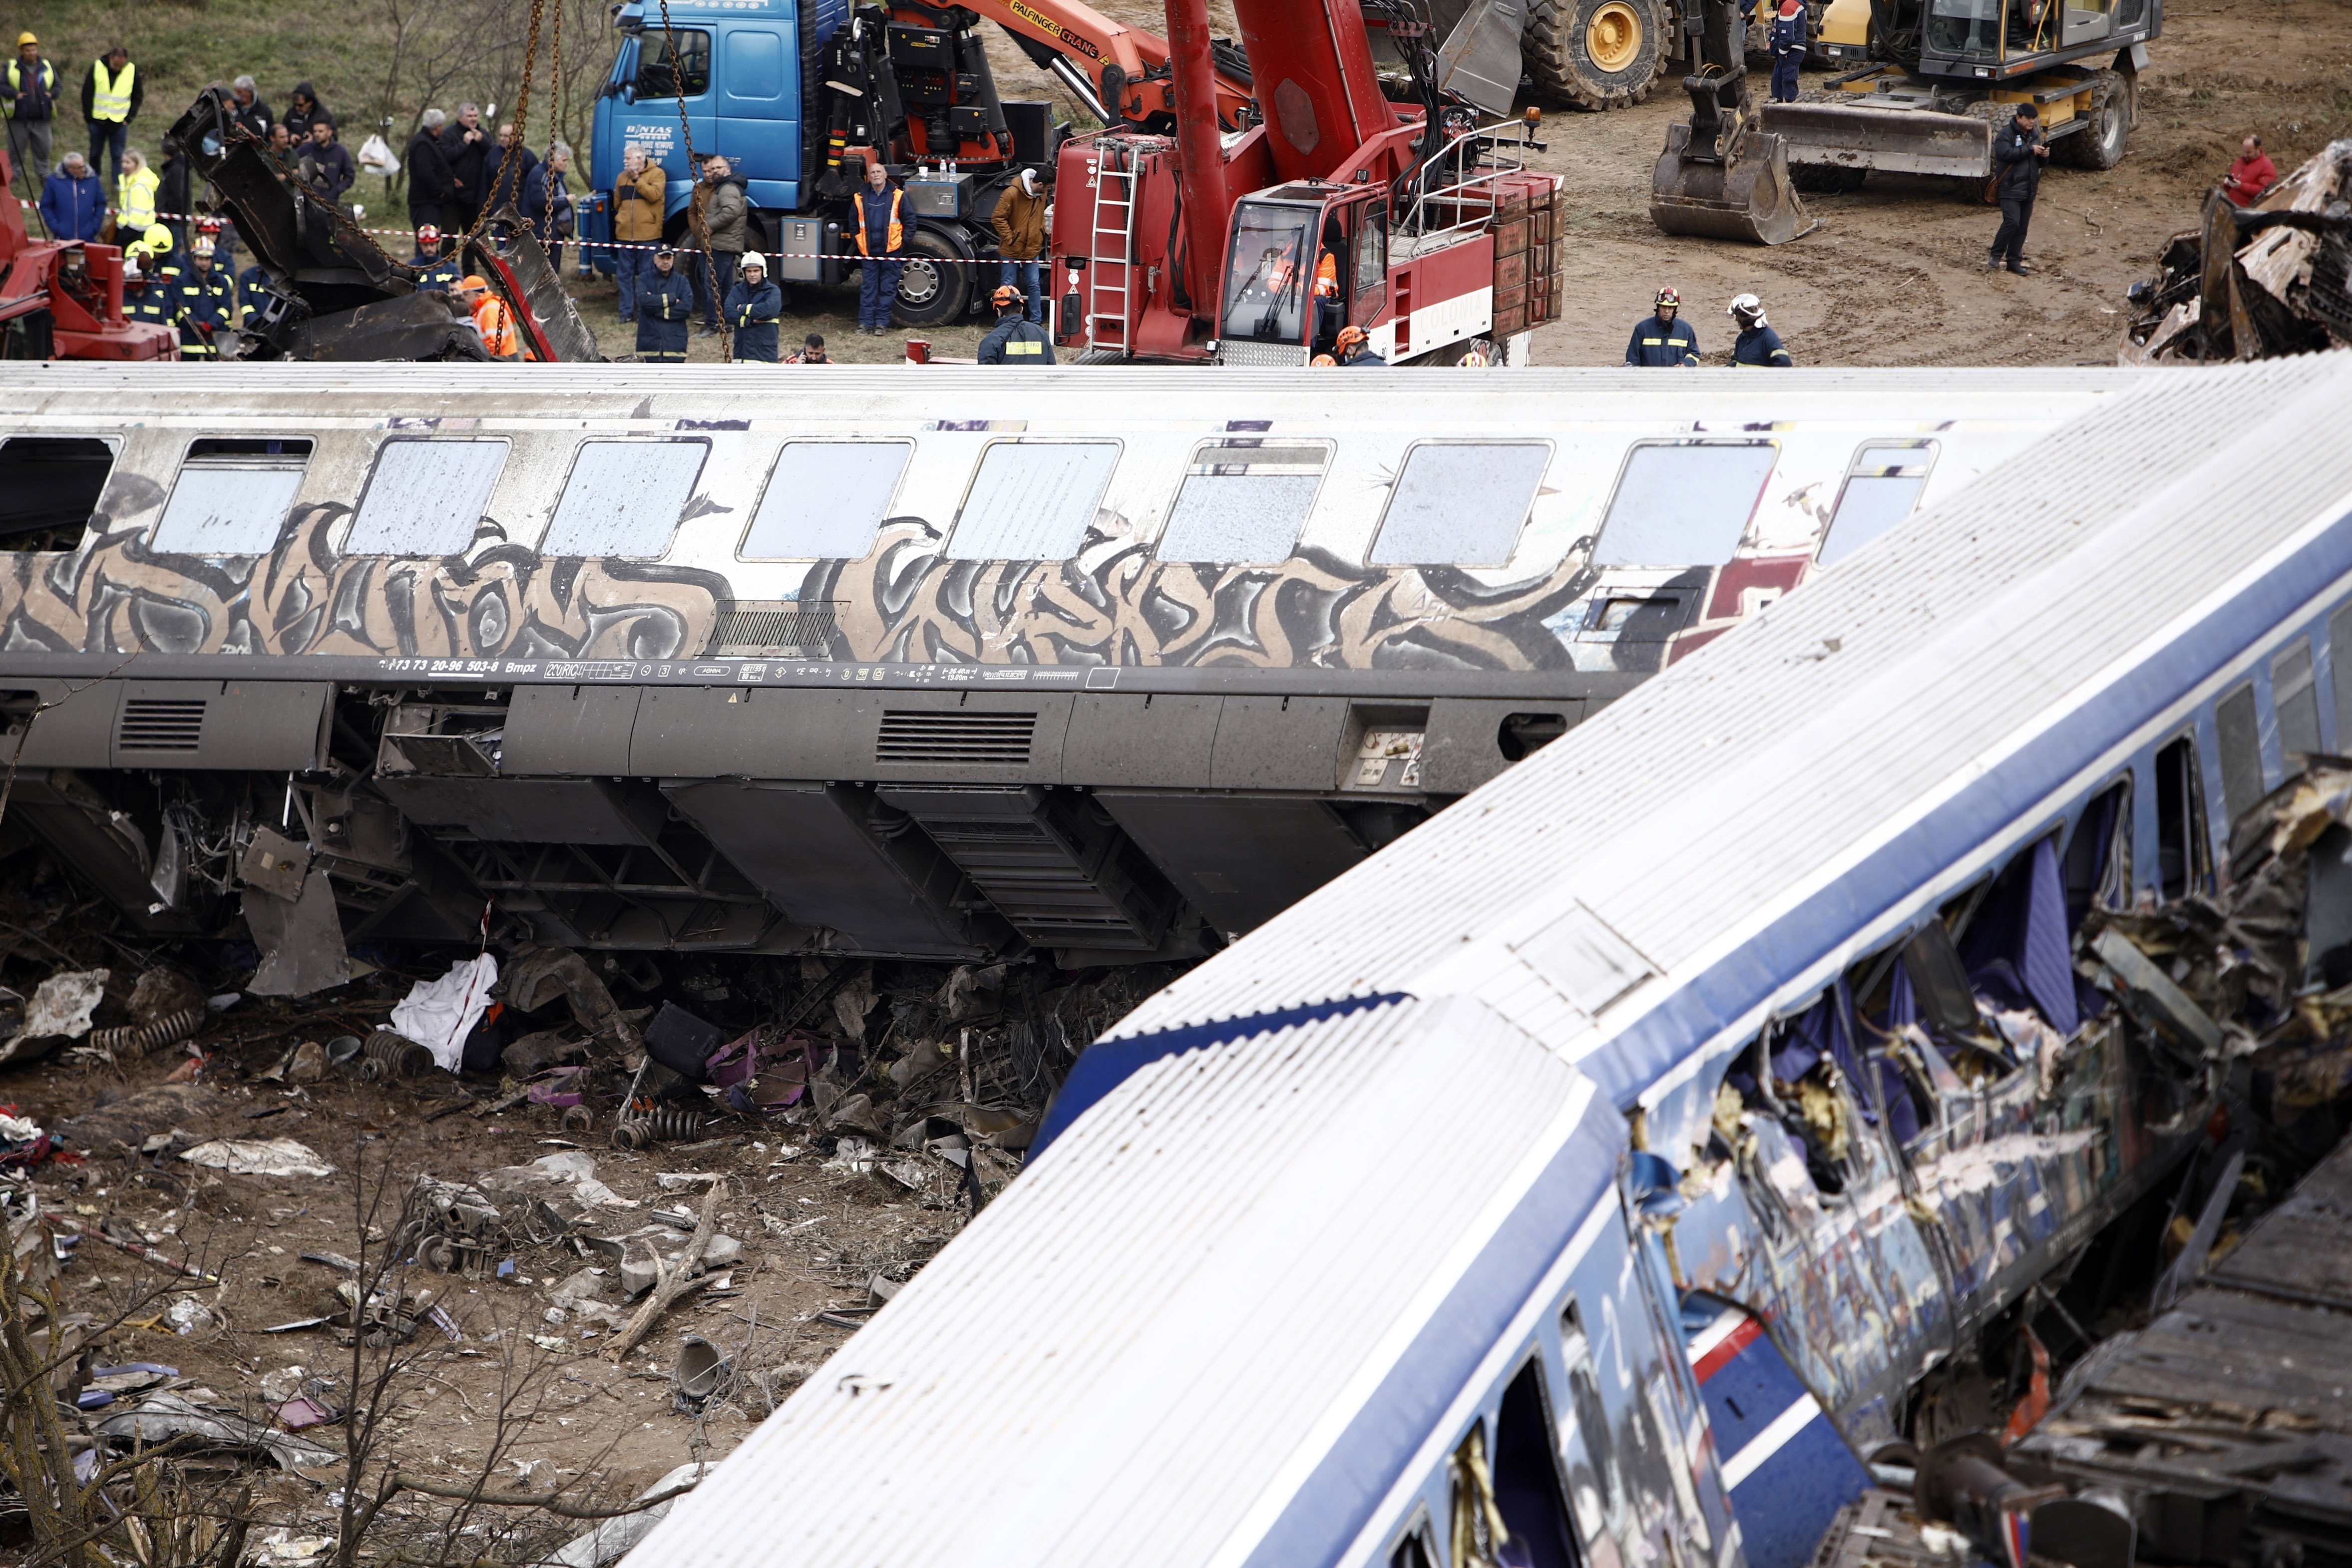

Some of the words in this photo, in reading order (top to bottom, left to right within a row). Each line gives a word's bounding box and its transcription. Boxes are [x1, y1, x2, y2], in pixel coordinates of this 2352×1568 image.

[1012, 1, 1061, 35] PALFINGER
[1062, 30, 1098, 57] CRANE
[413, 660, 428, 671] 73
[431, 660, 463, 671] 20-96
[466, 661, 499, 672] 503-8
[505, 662, 537, 675] Bmpz
